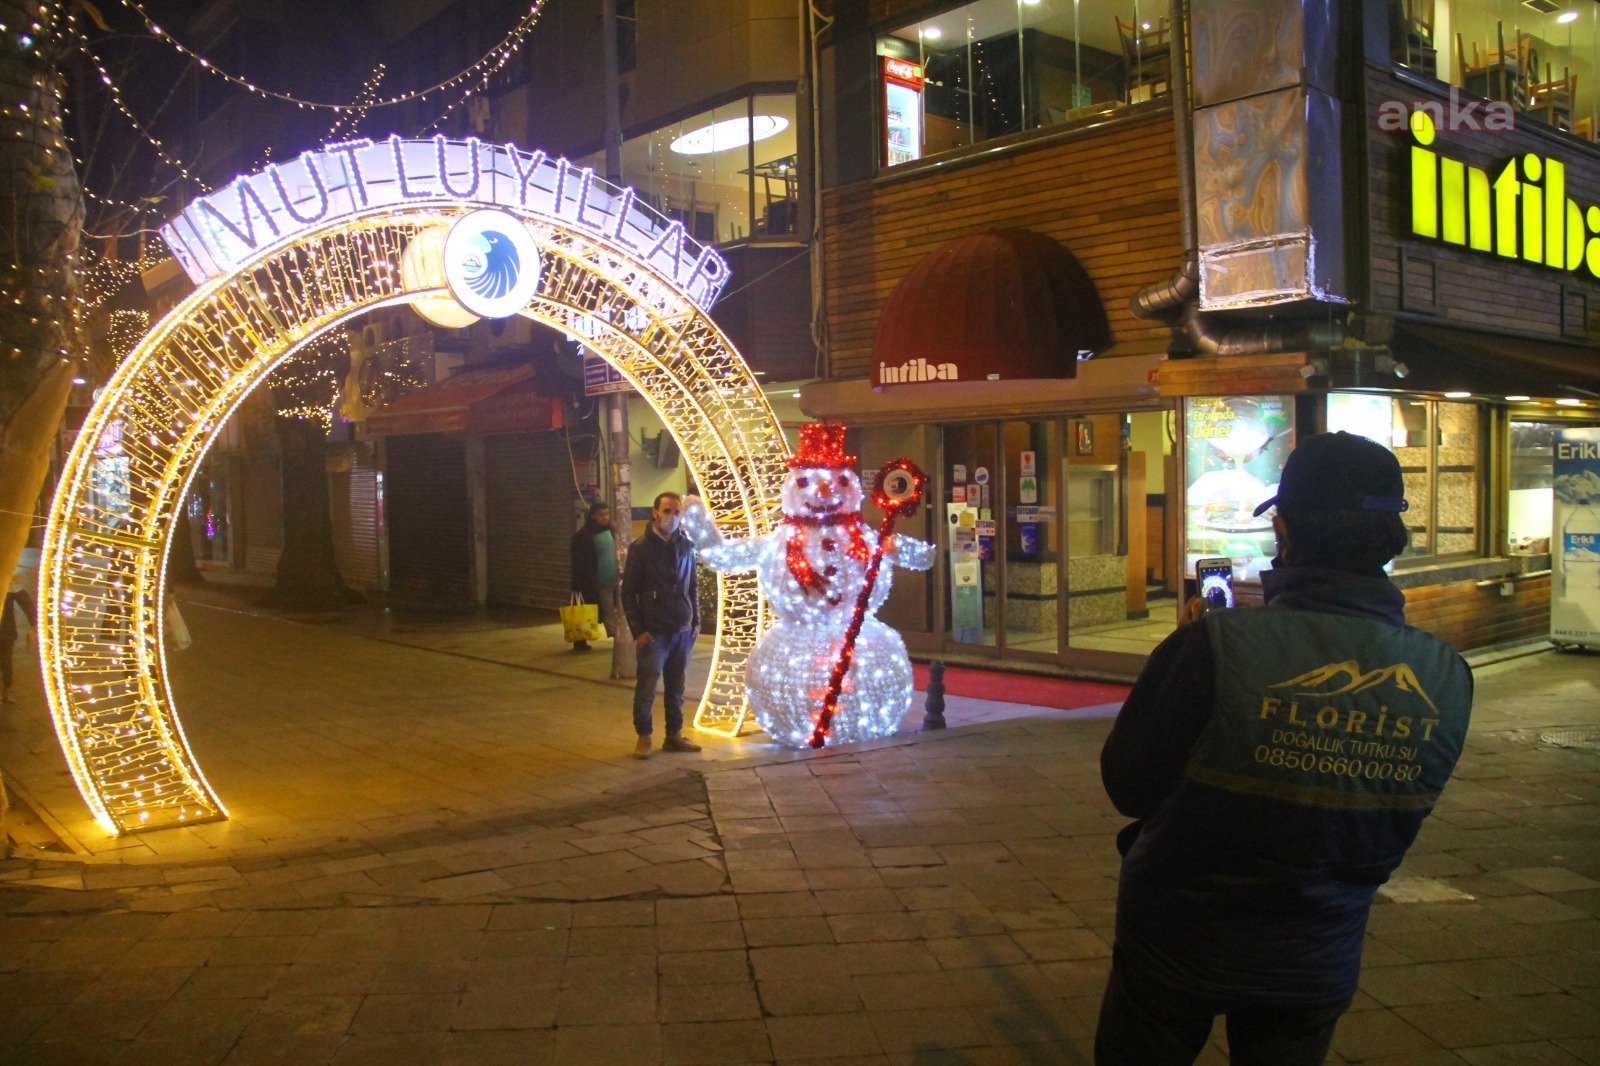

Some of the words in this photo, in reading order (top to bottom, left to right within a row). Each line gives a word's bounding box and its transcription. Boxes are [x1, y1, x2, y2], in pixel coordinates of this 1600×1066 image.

[192, 134, 481, 264] MUTLU
[505, 143, 731, 311] YILLAR
[880, 358, 958, 384] intiba
[1350, 739, 1397, 759] TUTKU
[1397, 746, 1418, 761] SU
